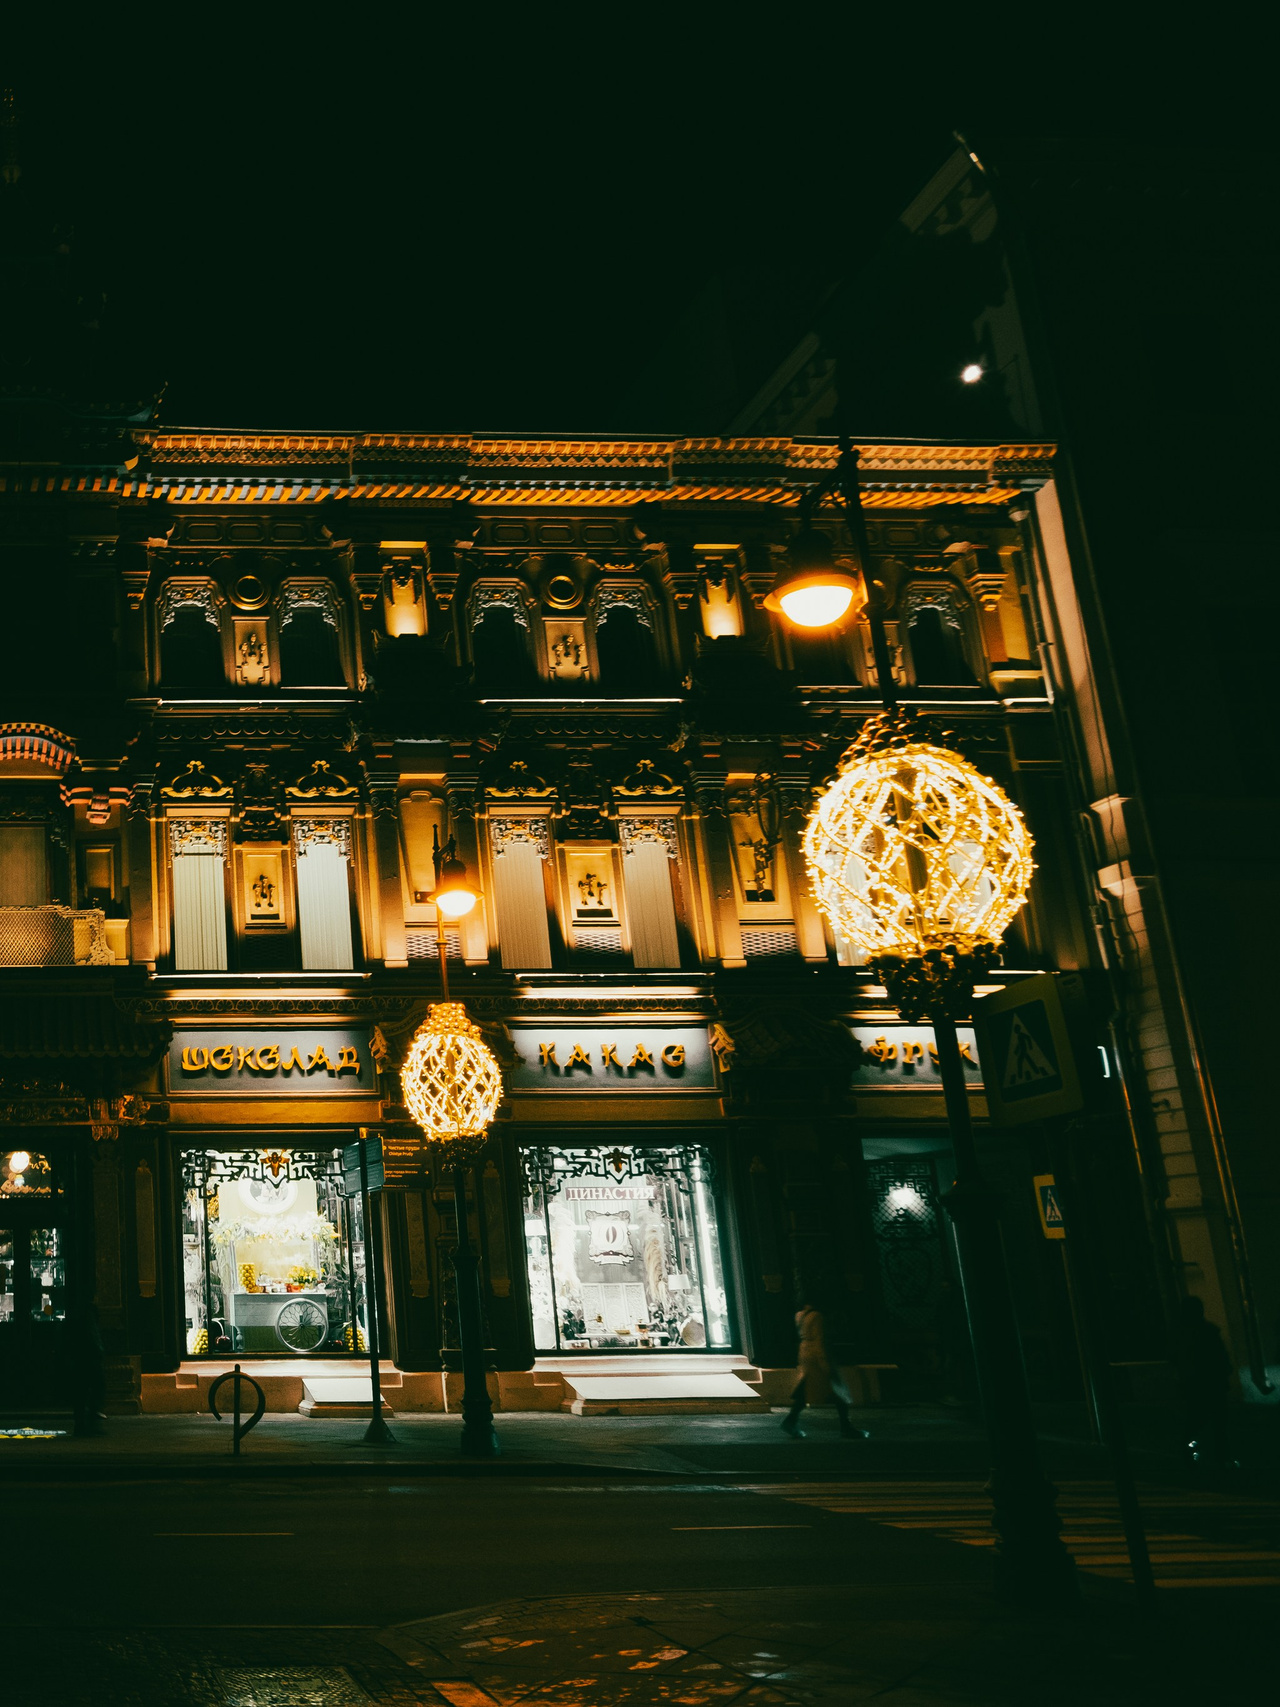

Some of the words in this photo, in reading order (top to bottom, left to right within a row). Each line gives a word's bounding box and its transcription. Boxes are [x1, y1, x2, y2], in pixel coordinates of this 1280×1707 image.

[180, 1043, 361, 1076] ШОКОЛАД
[539, 1041, 687, 1069] КАКАО
[866, 1035, 978, 1065] ФРУК
[567, 1187, 656, 1201] ДИНАСТИЯ
